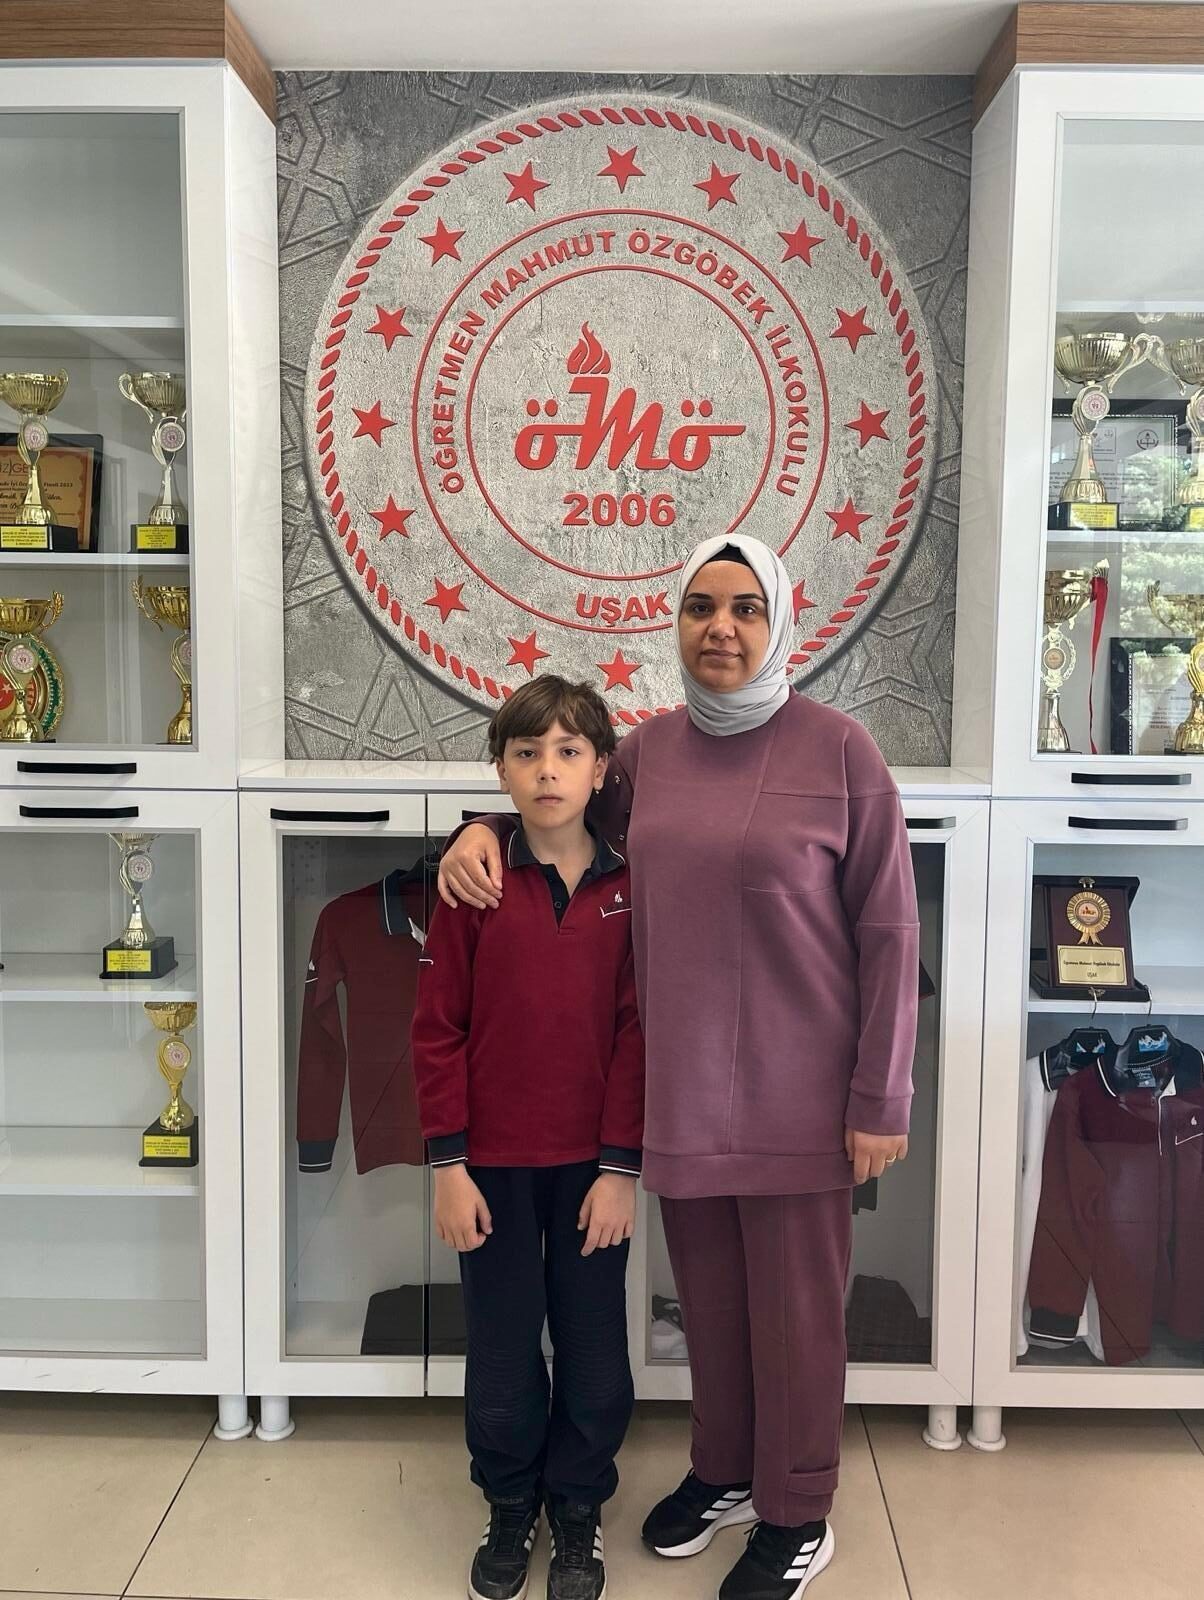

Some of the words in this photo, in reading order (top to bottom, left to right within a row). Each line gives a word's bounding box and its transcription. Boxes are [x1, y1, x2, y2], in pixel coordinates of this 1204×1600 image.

[432, 311, 486, 494] ÖĞRETMEN
[480, 231, 615, 309] MAHMUT
[627, 227, 773, 325] ÖZGÖBEK
[766, 322, 809, 497] İLKOKULU
[562, 492, 677, 528] 2006
[575, 591, 674, 627] UŞAK
